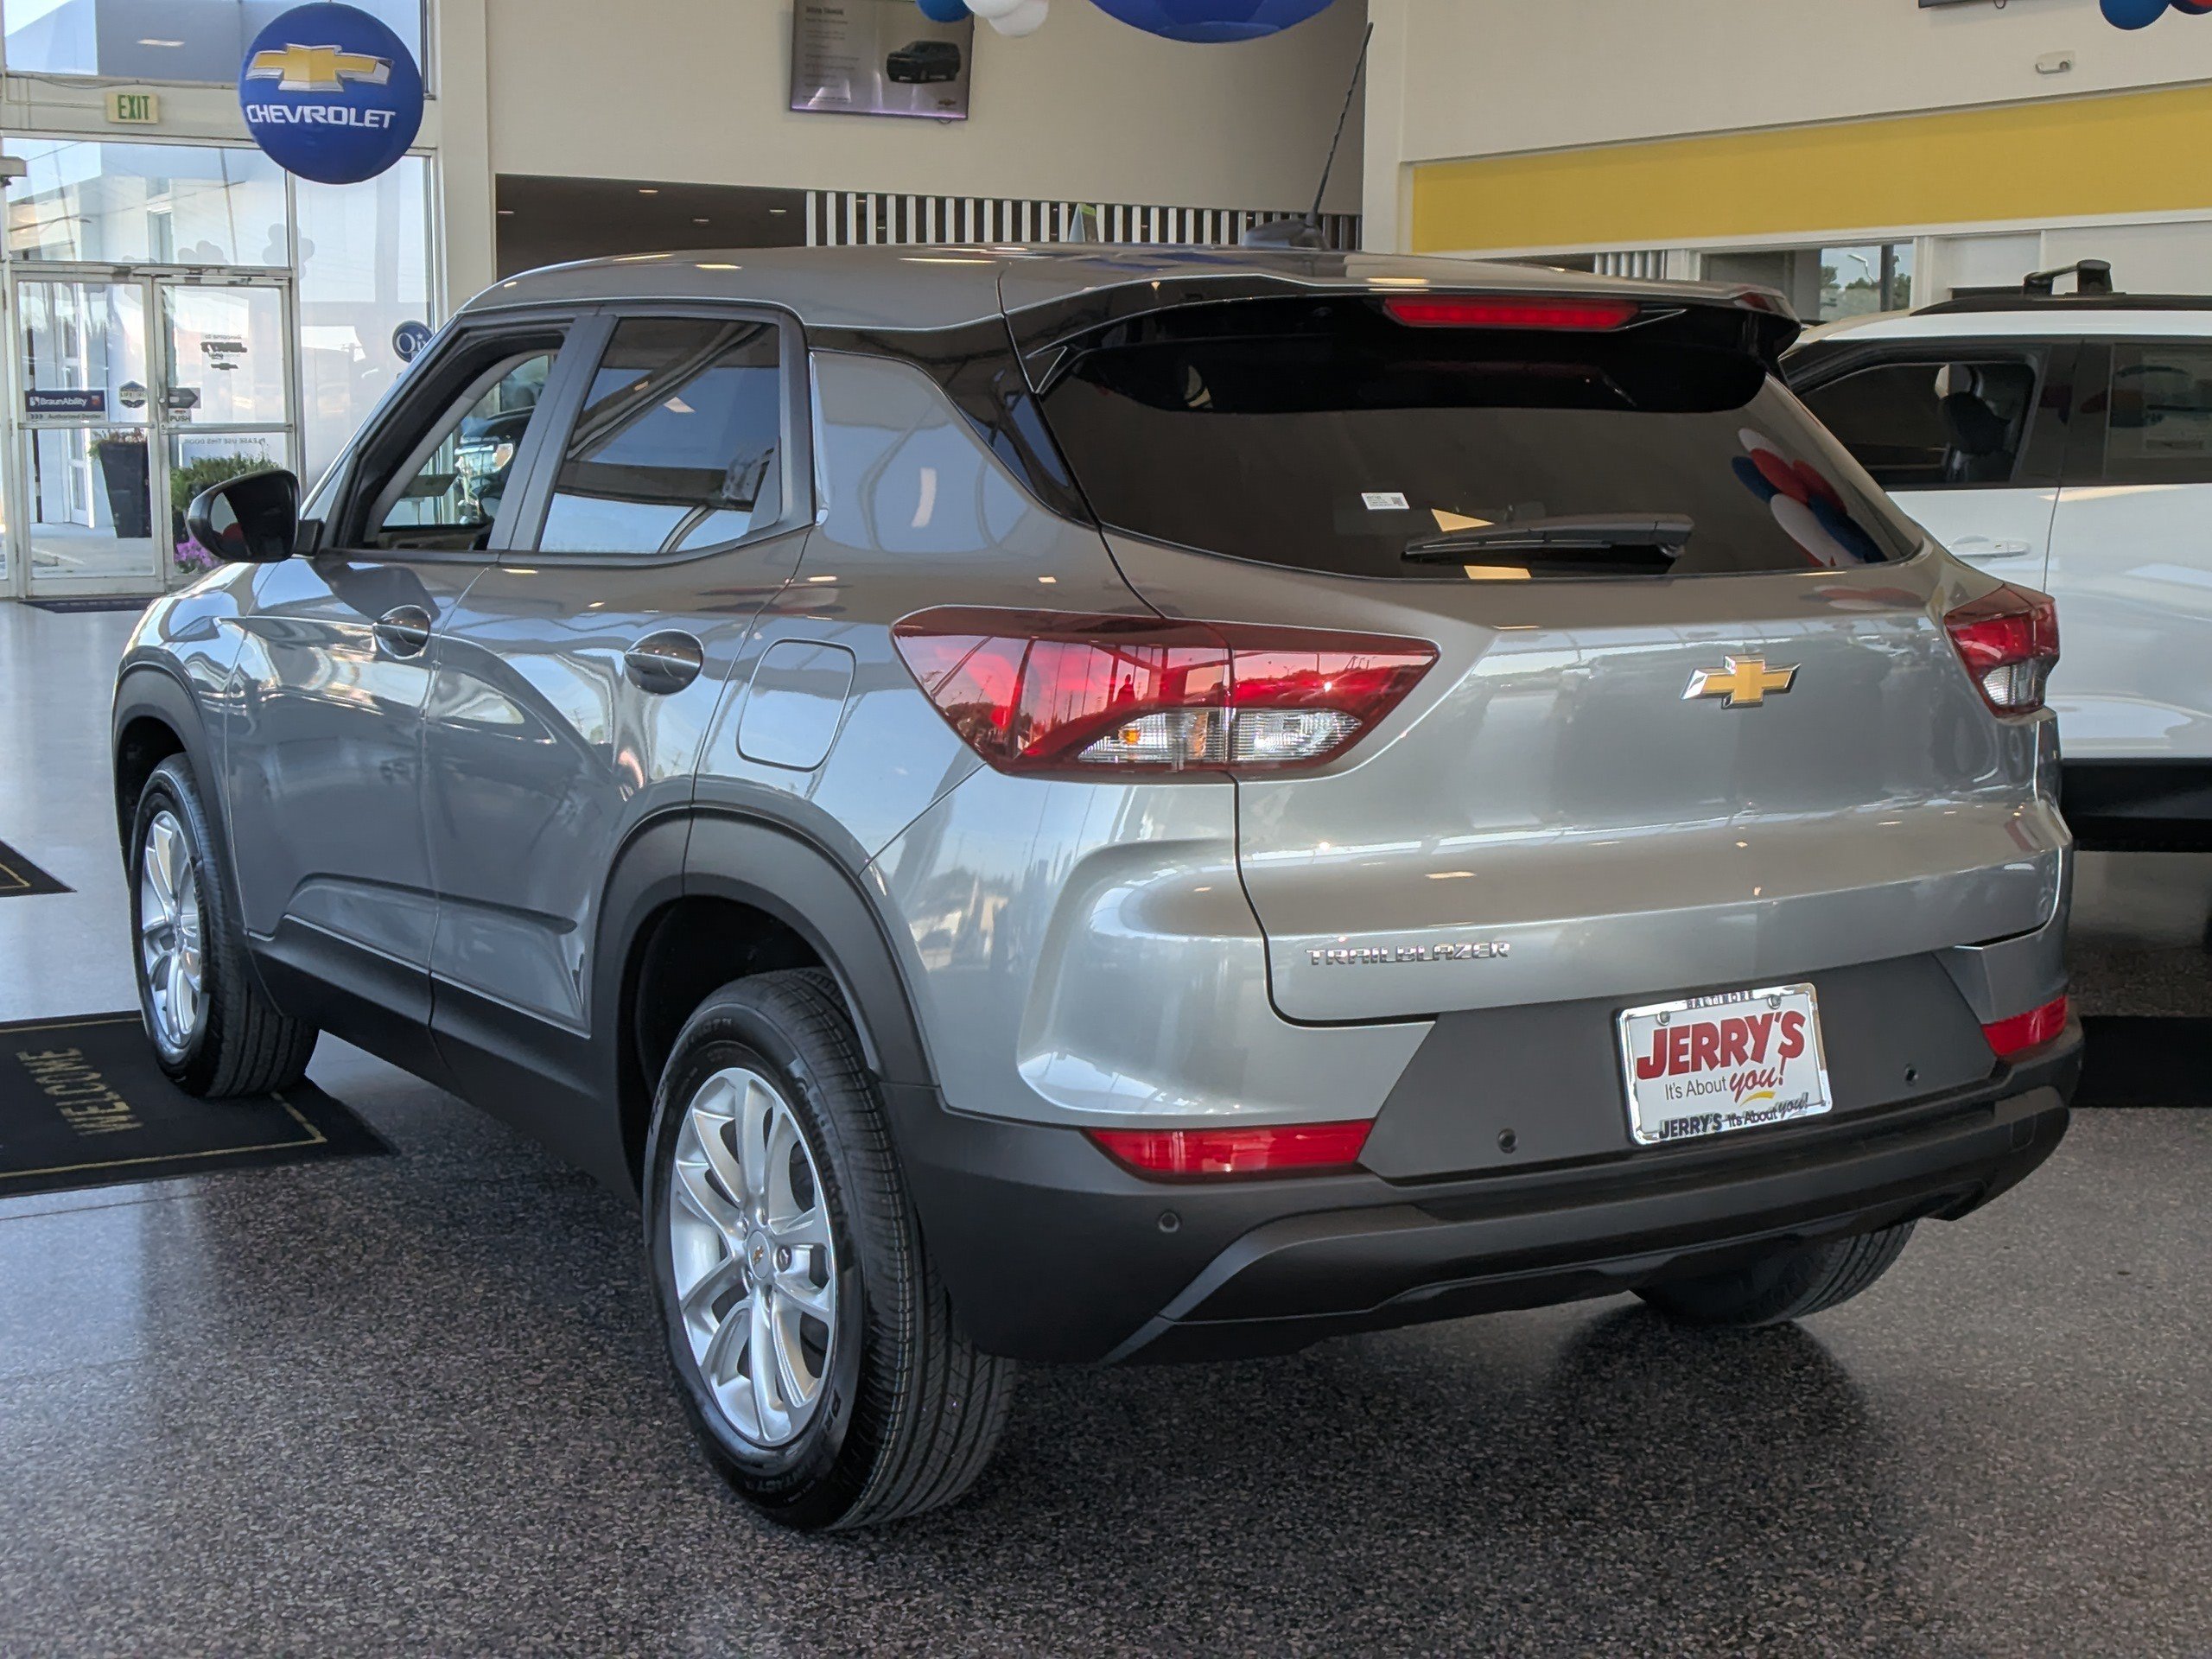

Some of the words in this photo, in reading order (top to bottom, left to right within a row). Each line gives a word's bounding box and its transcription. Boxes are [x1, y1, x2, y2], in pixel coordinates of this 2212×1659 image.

[118, 94, 149, 120] EXIT
[246, 104, 396, 129] CHEVROLET
[1305, 942, 1510, 965] TRAILBLAZER
[1687, 989, 1754, 1010] BALTIMORE
[1637, 1011, 1806, 1080] JERRY'S
[16, 1046, 144, 1136] WELCOME
[1665, 1083, 1683, 1101] It's
[1686, 1076, 1727, 1097] About
[1659, 1112, 1723, 1140] JERRY'S
[1744, 1109, 1778, 1125] About
